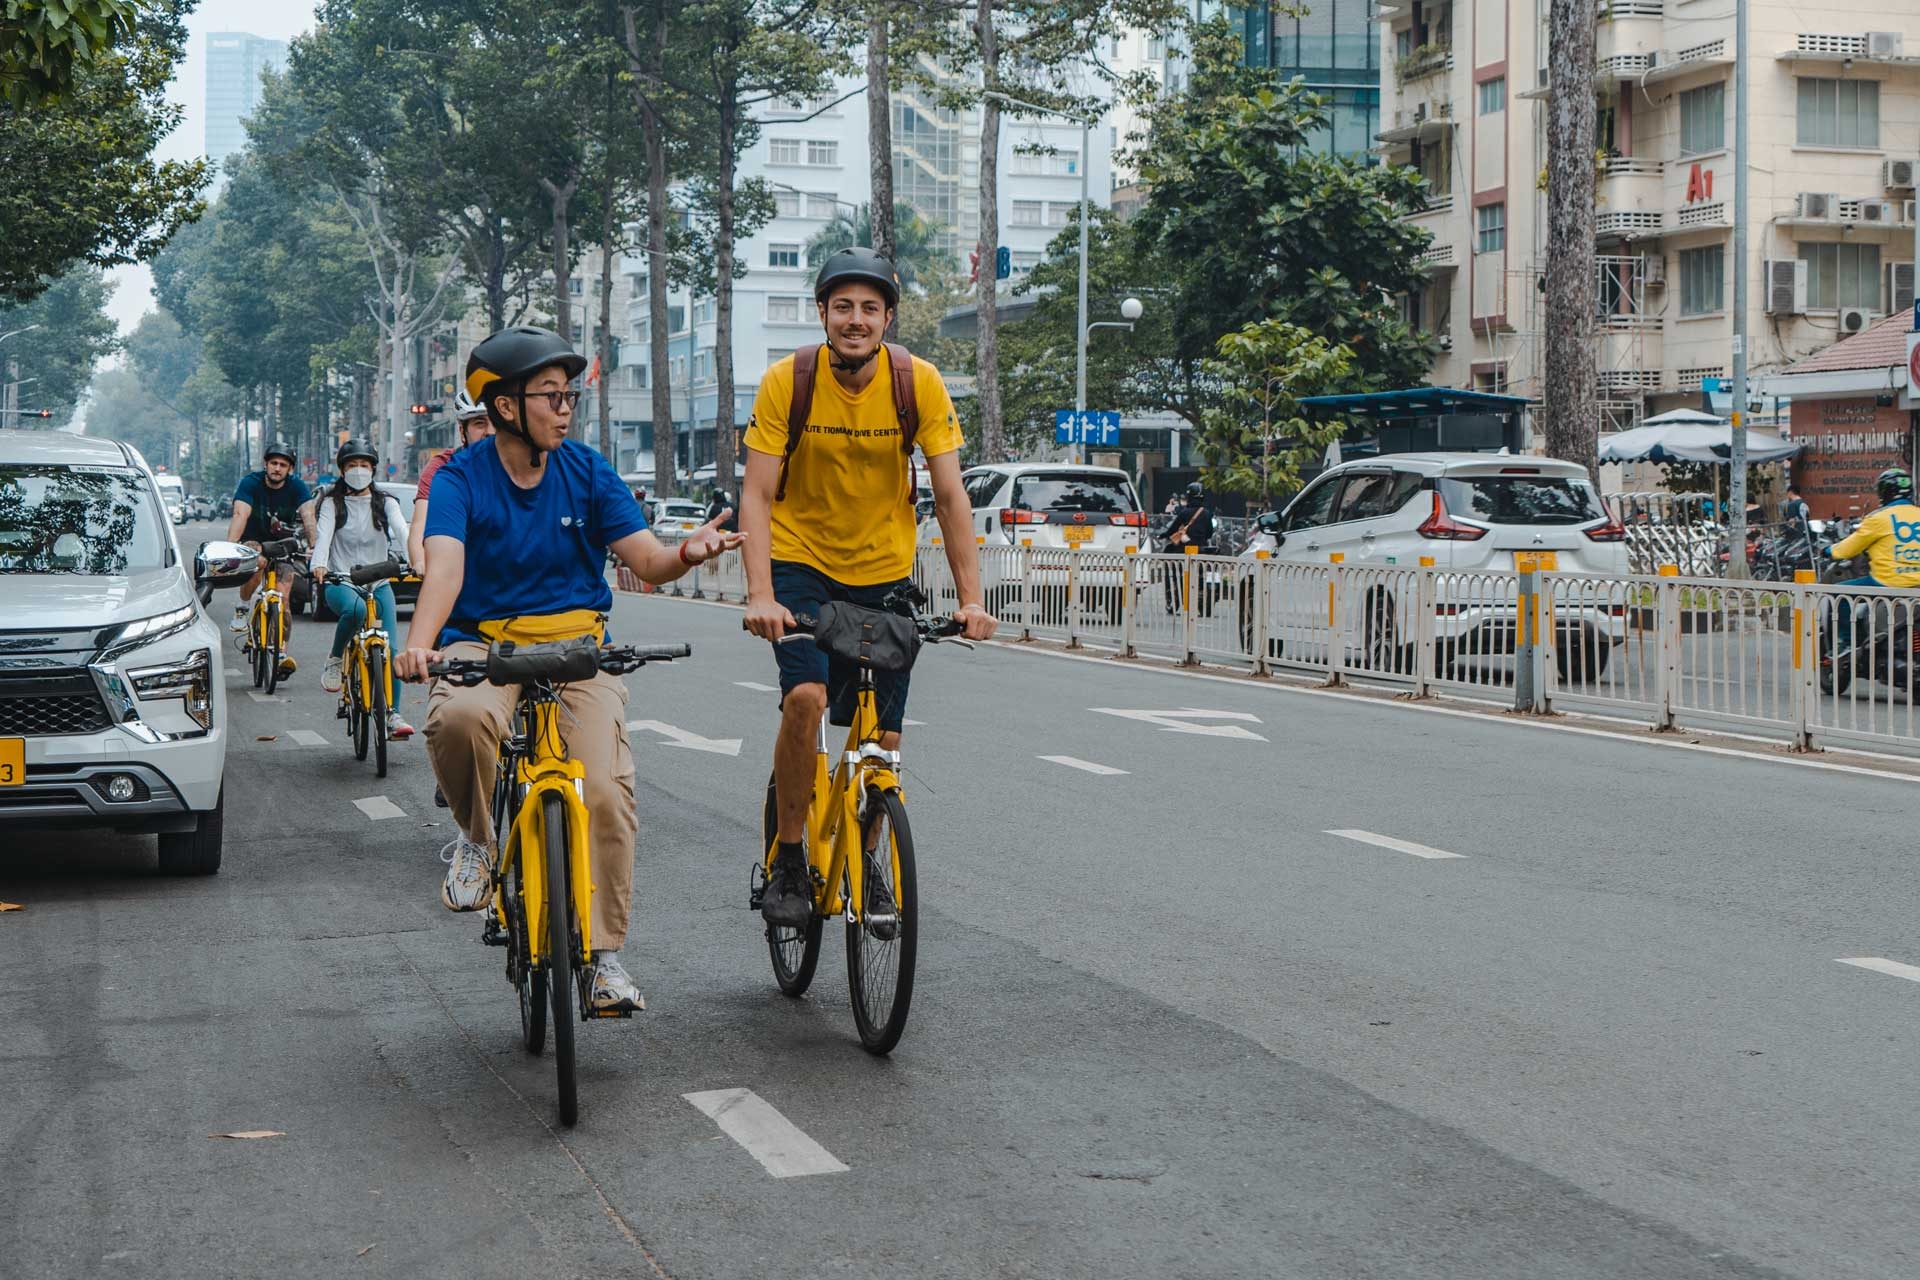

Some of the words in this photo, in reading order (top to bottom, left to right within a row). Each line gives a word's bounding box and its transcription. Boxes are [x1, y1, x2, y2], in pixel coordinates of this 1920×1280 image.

[1686, 163, 1713, 204] A1
[823, 426, 853, 437] TIOMAN
[854, 429, 871, 438] DIVE
